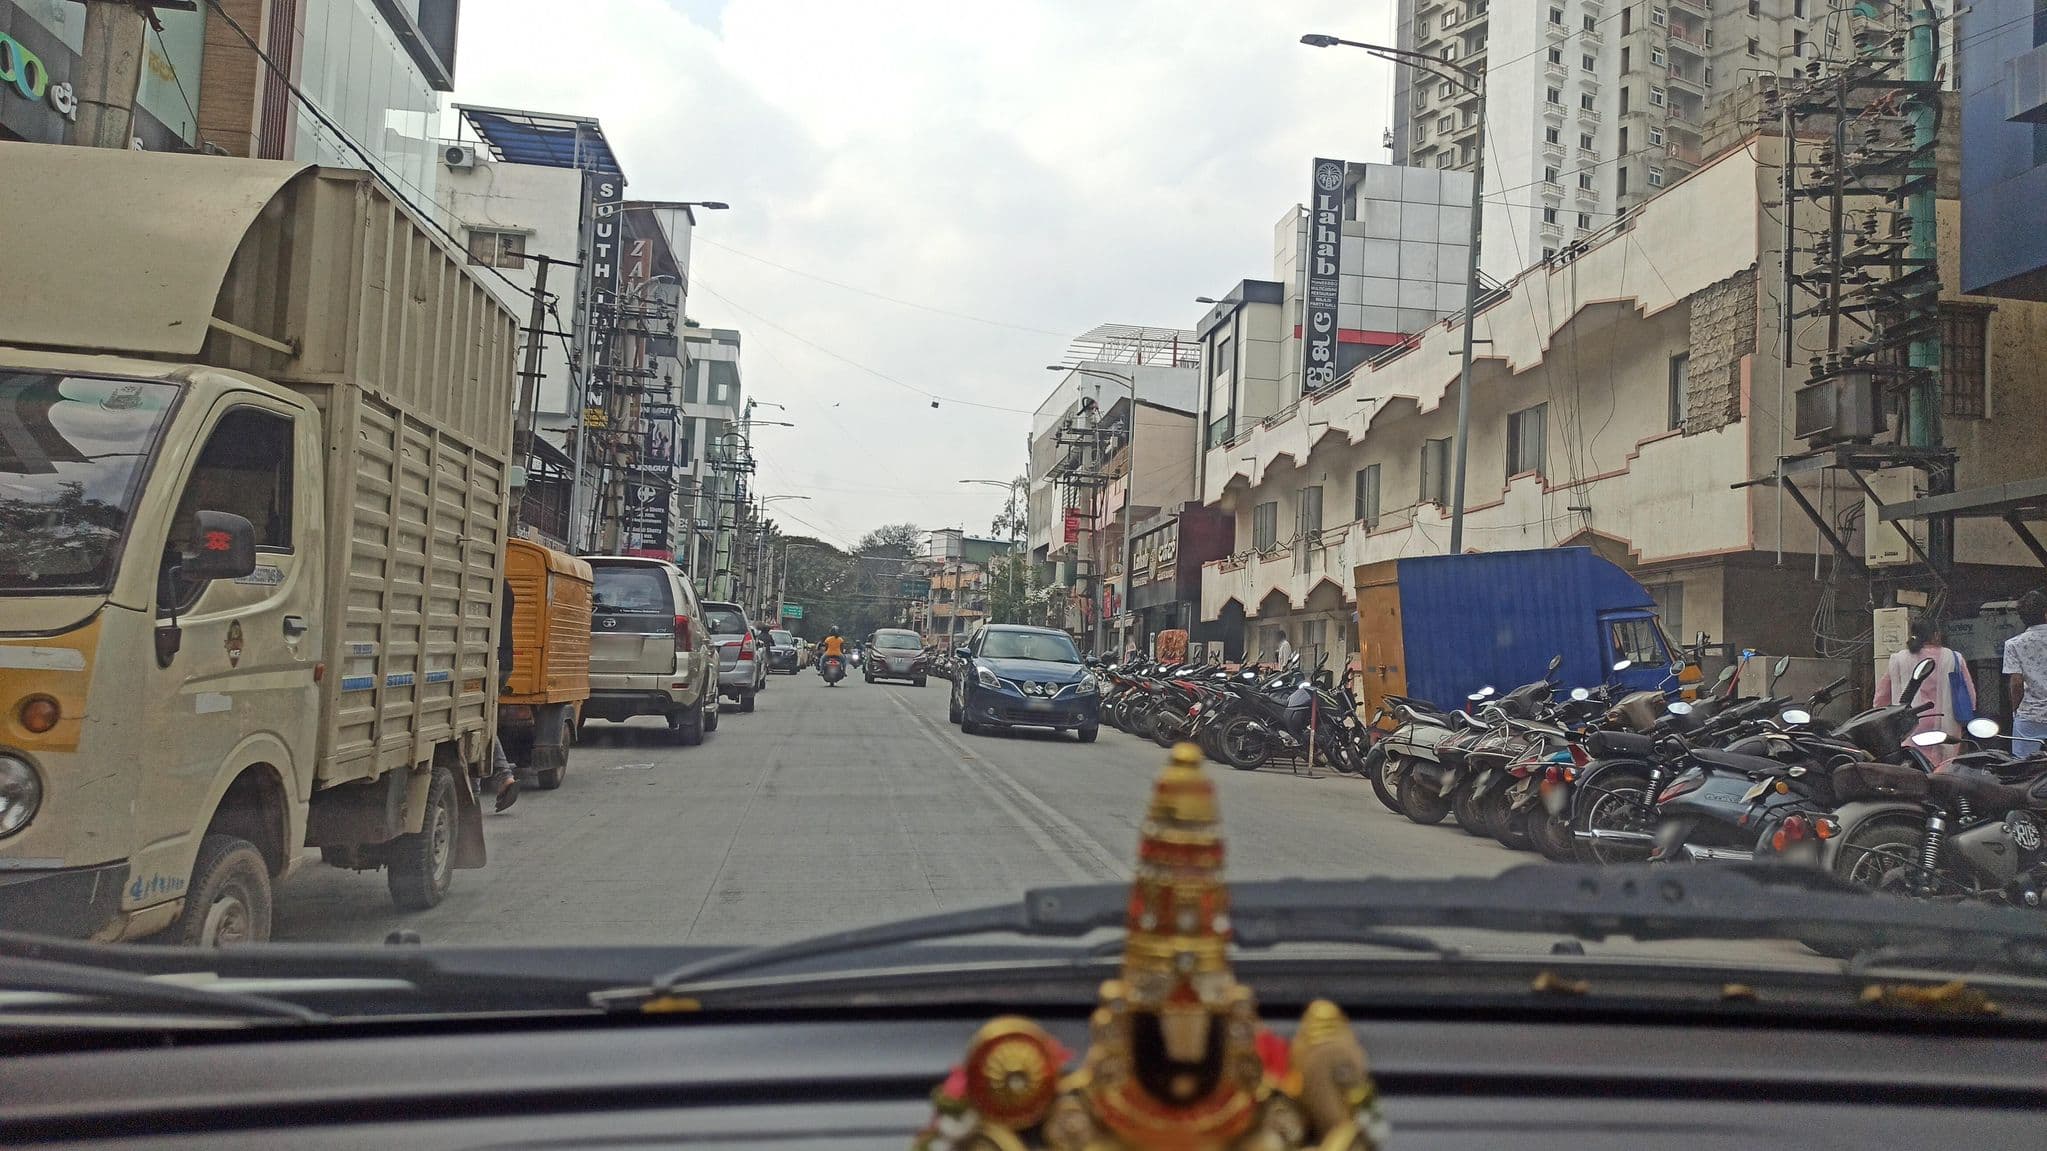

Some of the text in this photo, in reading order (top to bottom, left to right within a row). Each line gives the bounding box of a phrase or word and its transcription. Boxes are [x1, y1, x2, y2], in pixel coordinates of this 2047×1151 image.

[595, 183, 614, 278] SOUTH
[1316, 194, 1338, 276] Lahab
[587, 293, 607, 406] IIN
